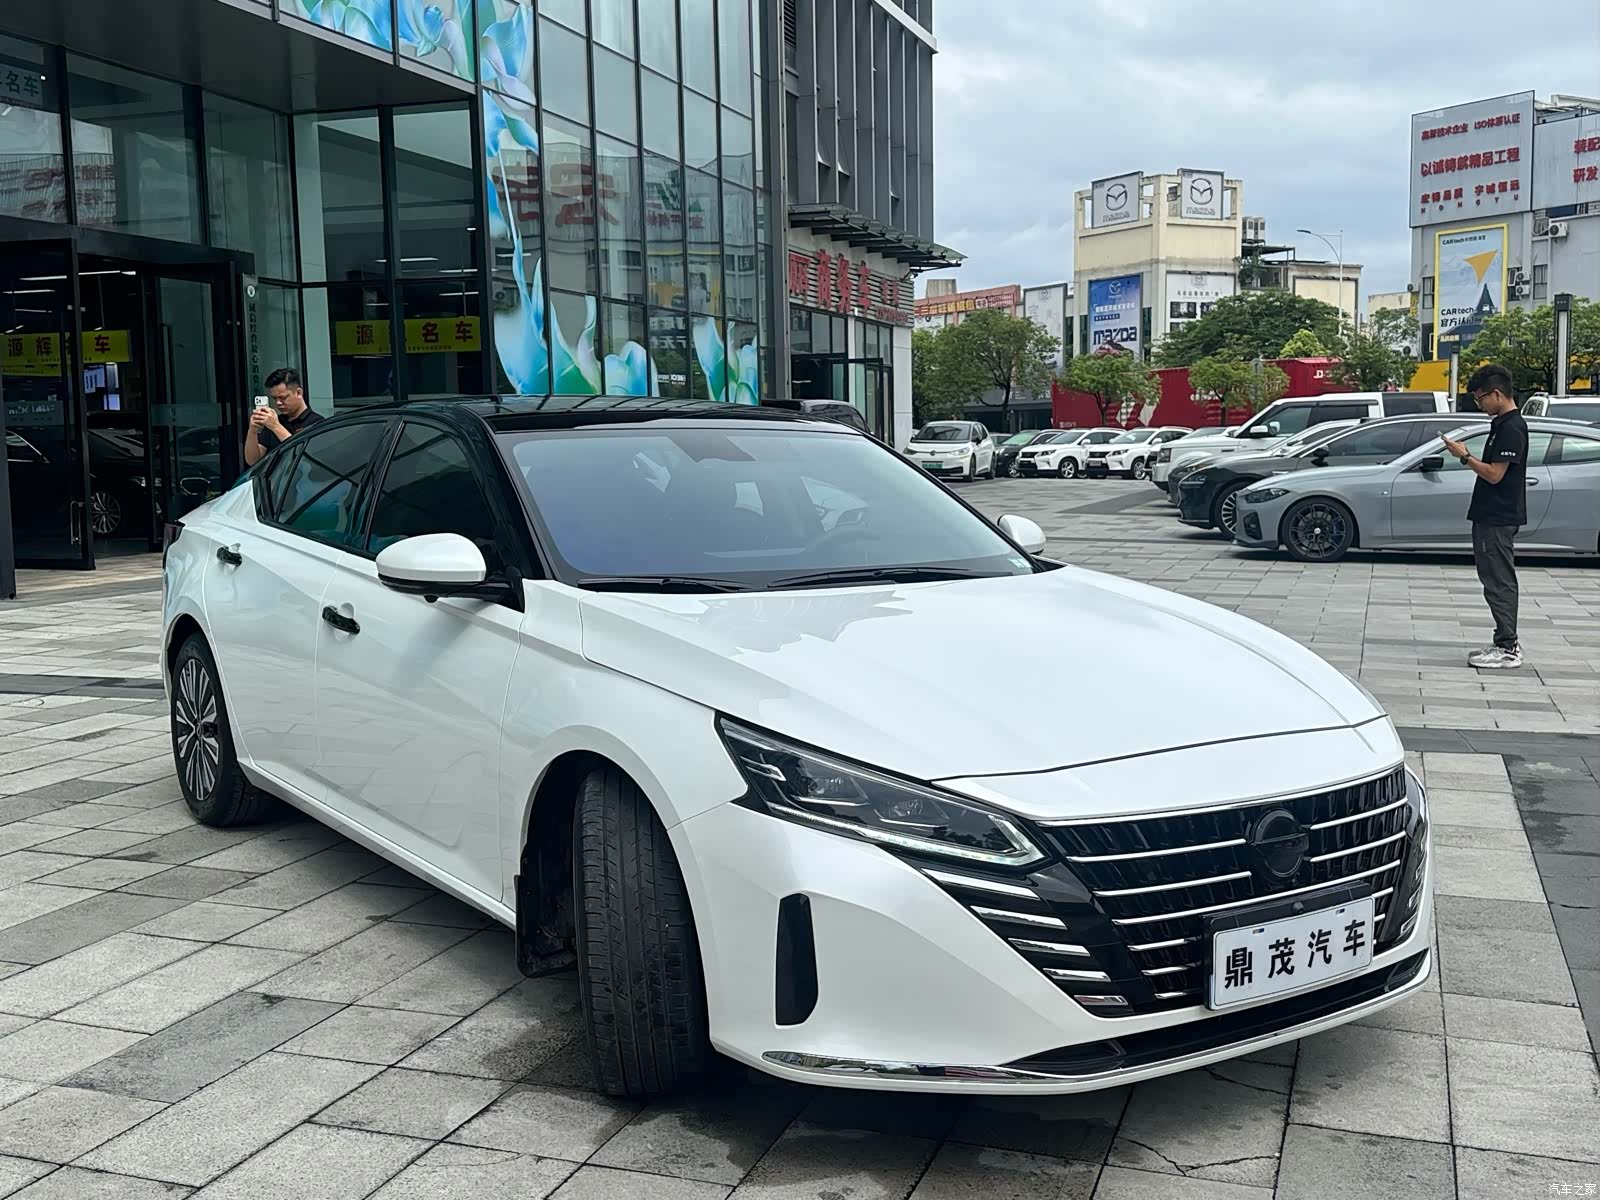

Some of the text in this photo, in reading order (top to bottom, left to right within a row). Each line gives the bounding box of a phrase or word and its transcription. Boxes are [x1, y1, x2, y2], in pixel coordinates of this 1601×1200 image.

[1573, 165, 1598, 184] 研发
[1440, 306, 1474, 316] CARtech
[1093, 326, 1137, 345] mazda
[1224, 919, 1365, 990] 鼎茂汽车
